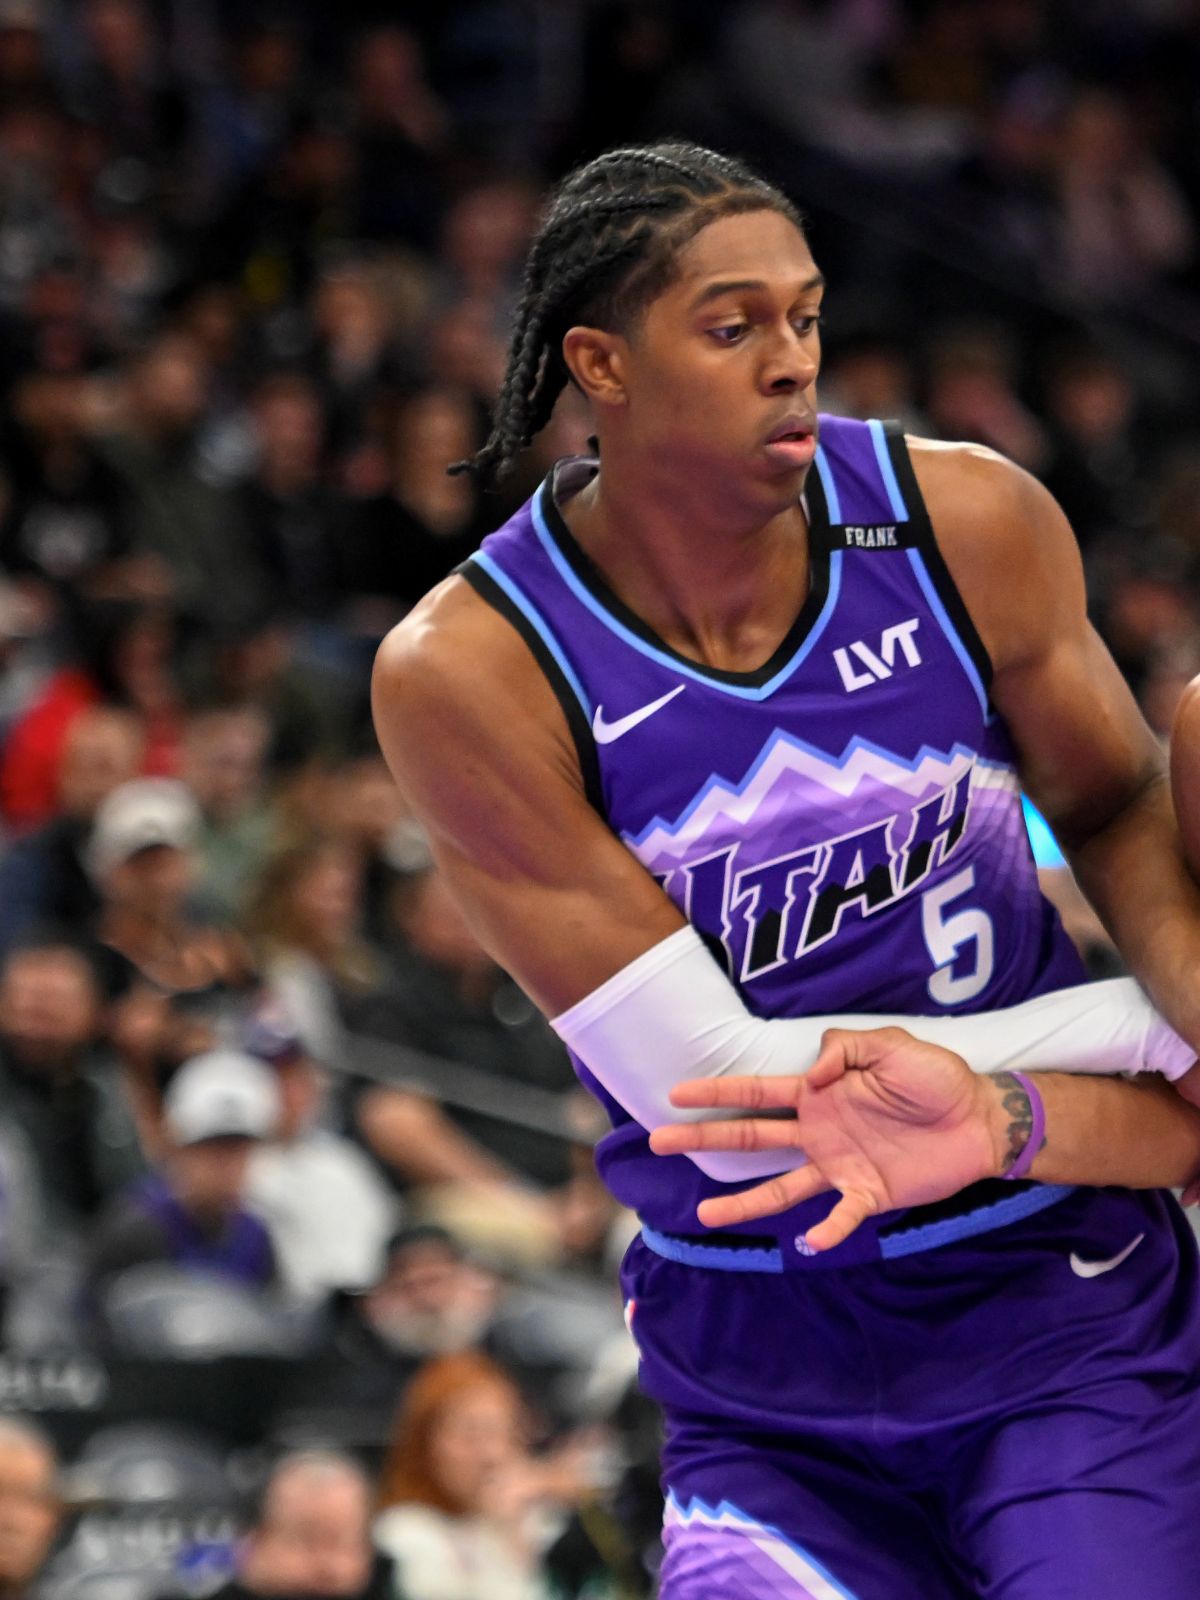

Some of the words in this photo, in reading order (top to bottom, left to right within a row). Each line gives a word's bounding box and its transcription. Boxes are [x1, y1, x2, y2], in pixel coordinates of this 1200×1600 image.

[845, 526, 898, 547] FRANK
[832, 617, 922, 693] LVT
[921, 864, 994, 1005] 5
